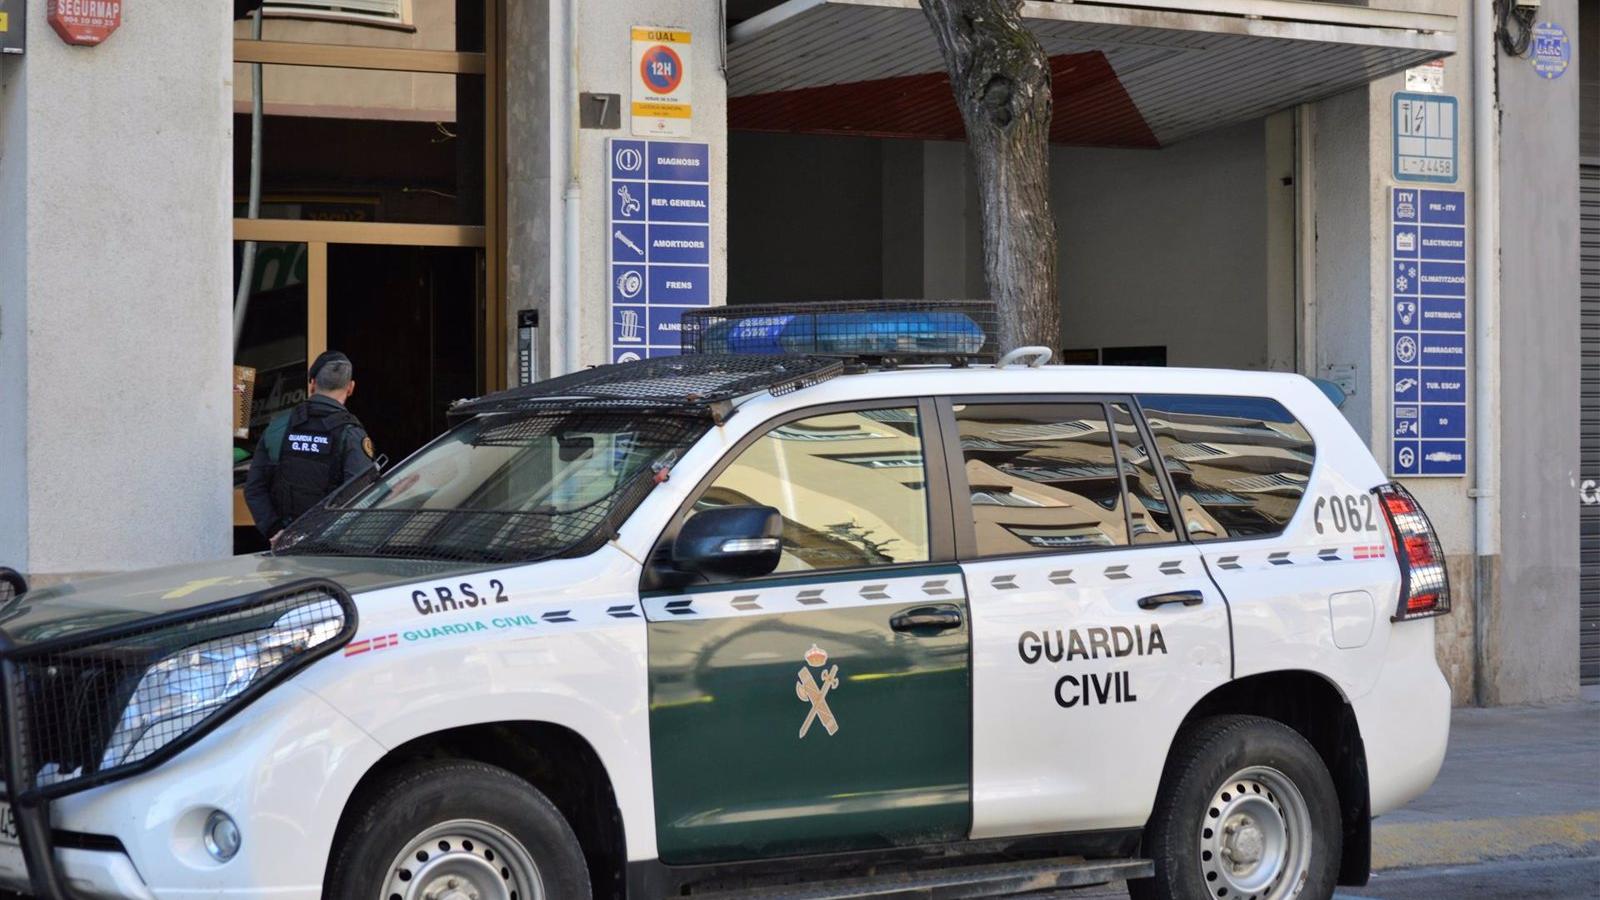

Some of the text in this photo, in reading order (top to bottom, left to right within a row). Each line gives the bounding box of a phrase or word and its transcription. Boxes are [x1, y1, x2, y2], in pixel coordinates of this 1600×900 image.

[58, 0, 119, 18] SEGURMAP
[648, 31, 676, 41] GUAL
[651, 62, 672, 76] 12H
[592, 94, 610, 126] 7
[657, 157, 700, 167] DIAGNOSIS
[1399, 192, 1413, 202] ITV
[652, 198, 706, 208] REP. GENERAL
[1446, 204, 1456, 212] ITV
[653, 239, 704, 249] AMORTIDORS
[1422, 239, 1463, 248] ELECTRICITAT
[666, 281, 692, 290] FRENS
[1441, 382, 1461, 390] ESCAP
[288, 434, 328, 444] GUARDIA CIVIL
[292, 442, 320, 453] G.R.S.
[1330, 494, 1377, 533] 062
[412, 579, 509, 615] G.R.S. 2
[403, 614, 538, 642] GUARDIA CIVIL
[1018, 623, 1168, 664] GUARDIA
[1054, 671, 1137, 708] CIVIL
